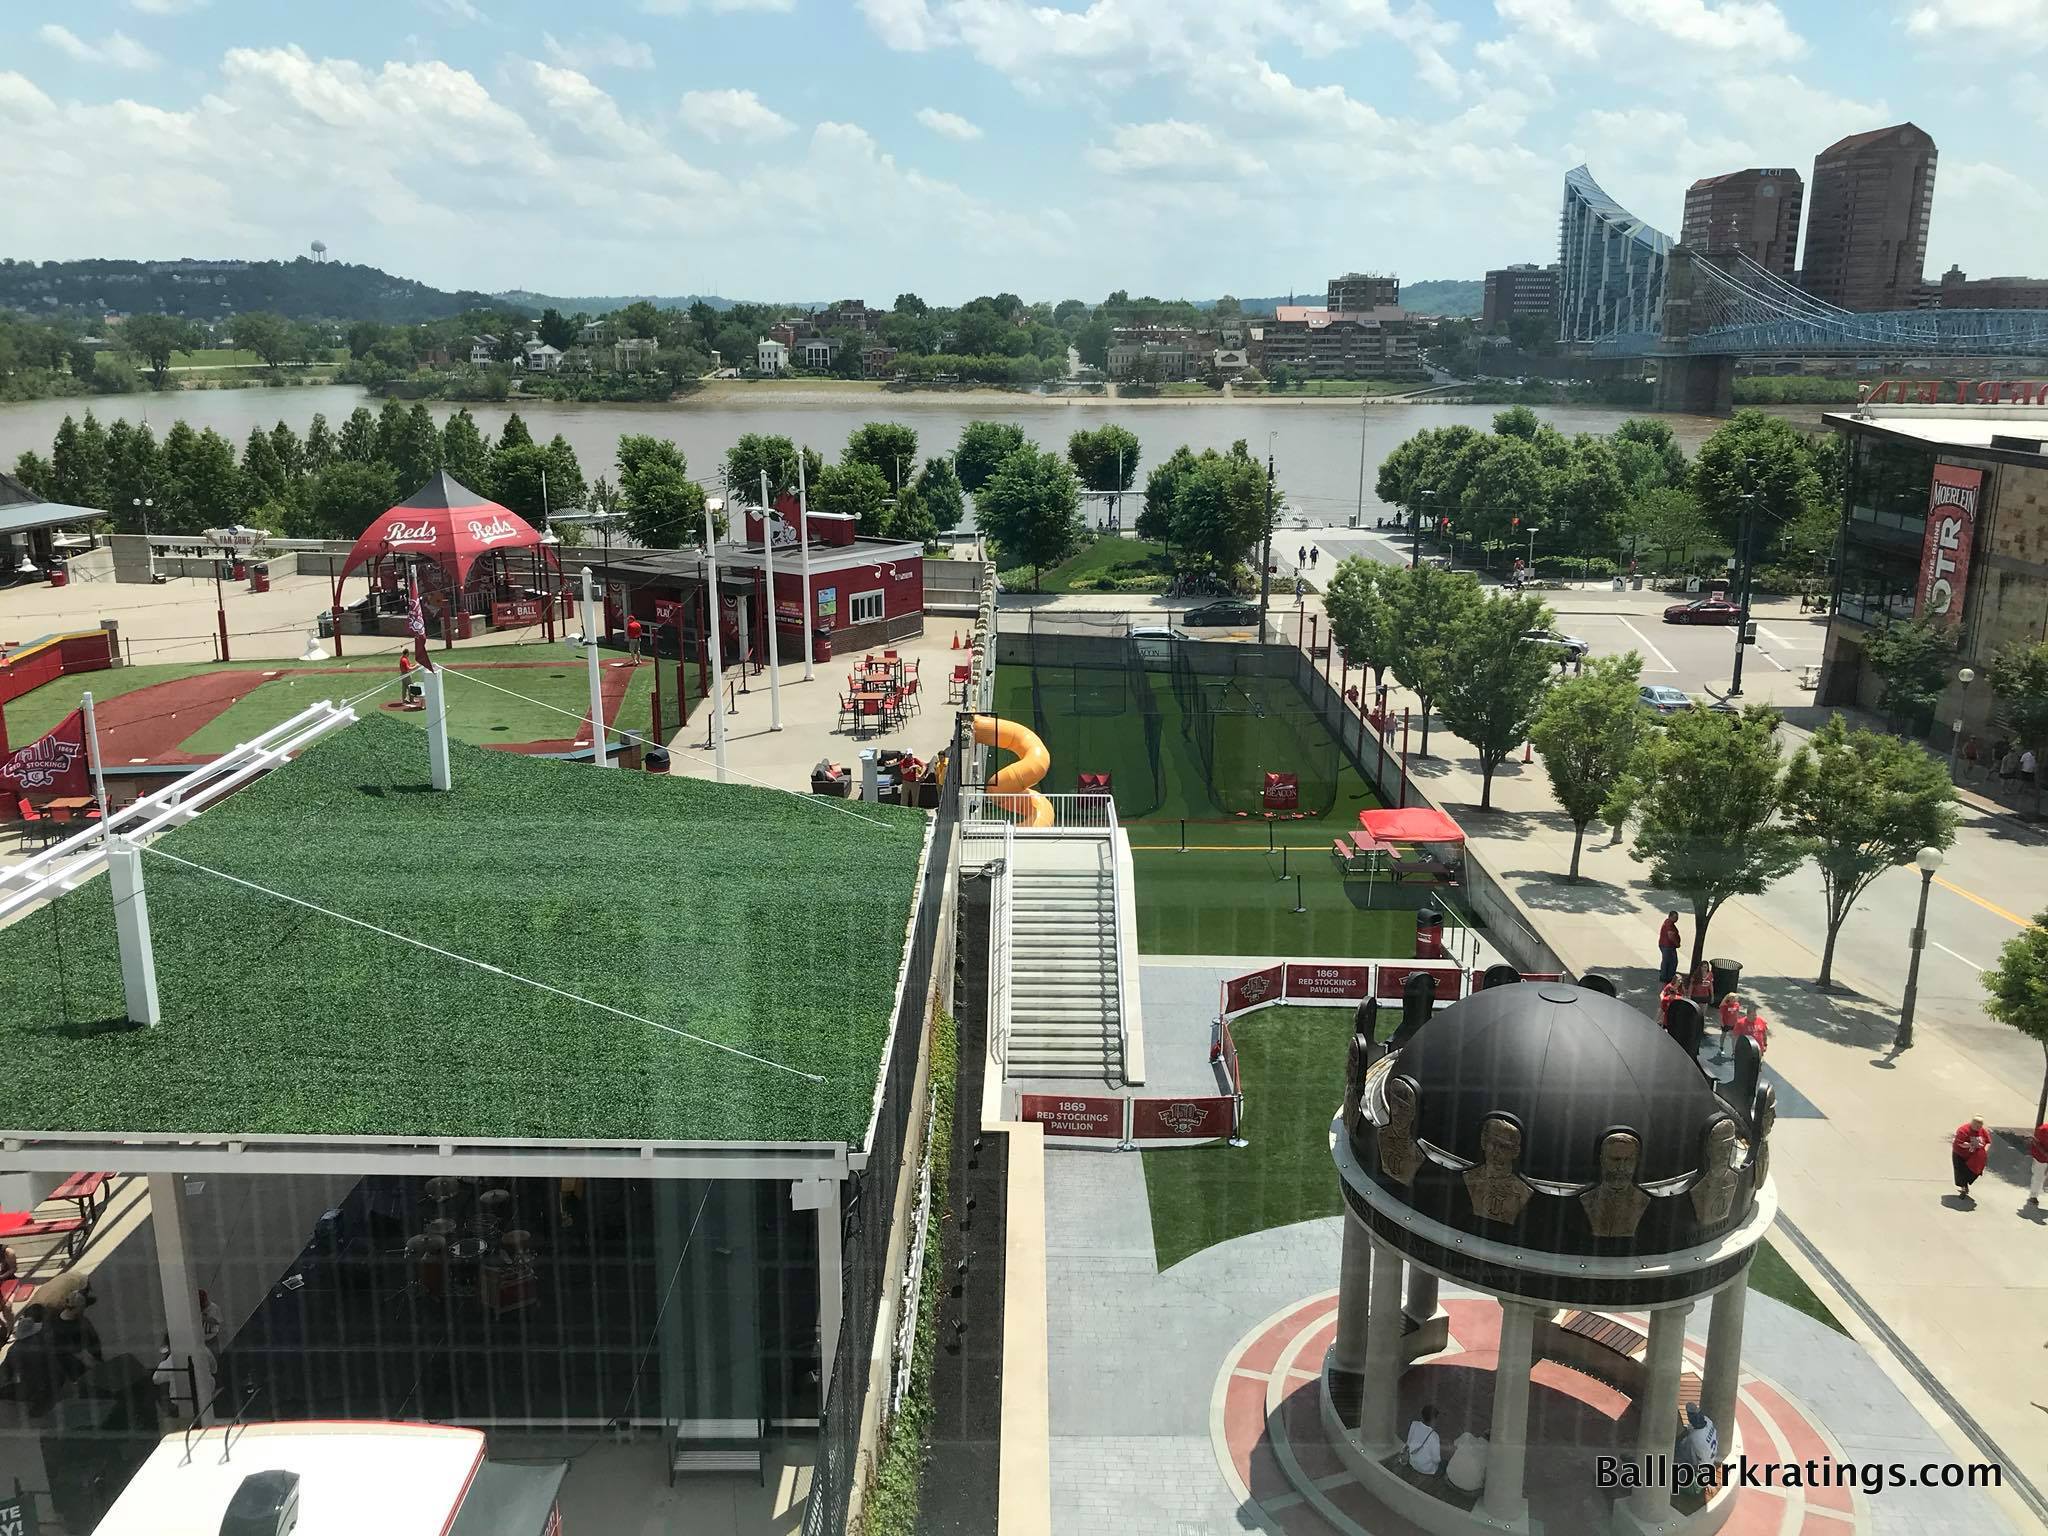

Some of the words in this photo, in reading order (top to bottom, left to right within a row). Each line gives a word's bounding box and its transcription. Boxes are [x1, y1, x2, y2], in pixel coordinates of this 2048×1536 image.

[1931, 481, 1977, 519] MOERLEIN
[383, 521, 437, 547] Reds
[468, 515, 518, 544] Reds
[234, 536, 252, 545] ZONE
[1931, 515, 1962, 614] OTR
[517, 606, 537, 616] BALL
[656, 607, 670, 618] PLAY
[26, 761, 67, 769] STOCKINGS
[1266, 786, 1297, 797] BEACON
[1316, 969, 1339, 978] 1869
[1314, 978, 1357, 986] STOCKINGS
[1310, 986, 1345, 994] PAVILION
[1058, 1101, 1086, 1112] 1869
[1036, 1111, 1055, 1119] RED
[1056, 1112, 1109, 1122] STOCKINGS
[1051, 1121, 1094, 1131] PAVILION
